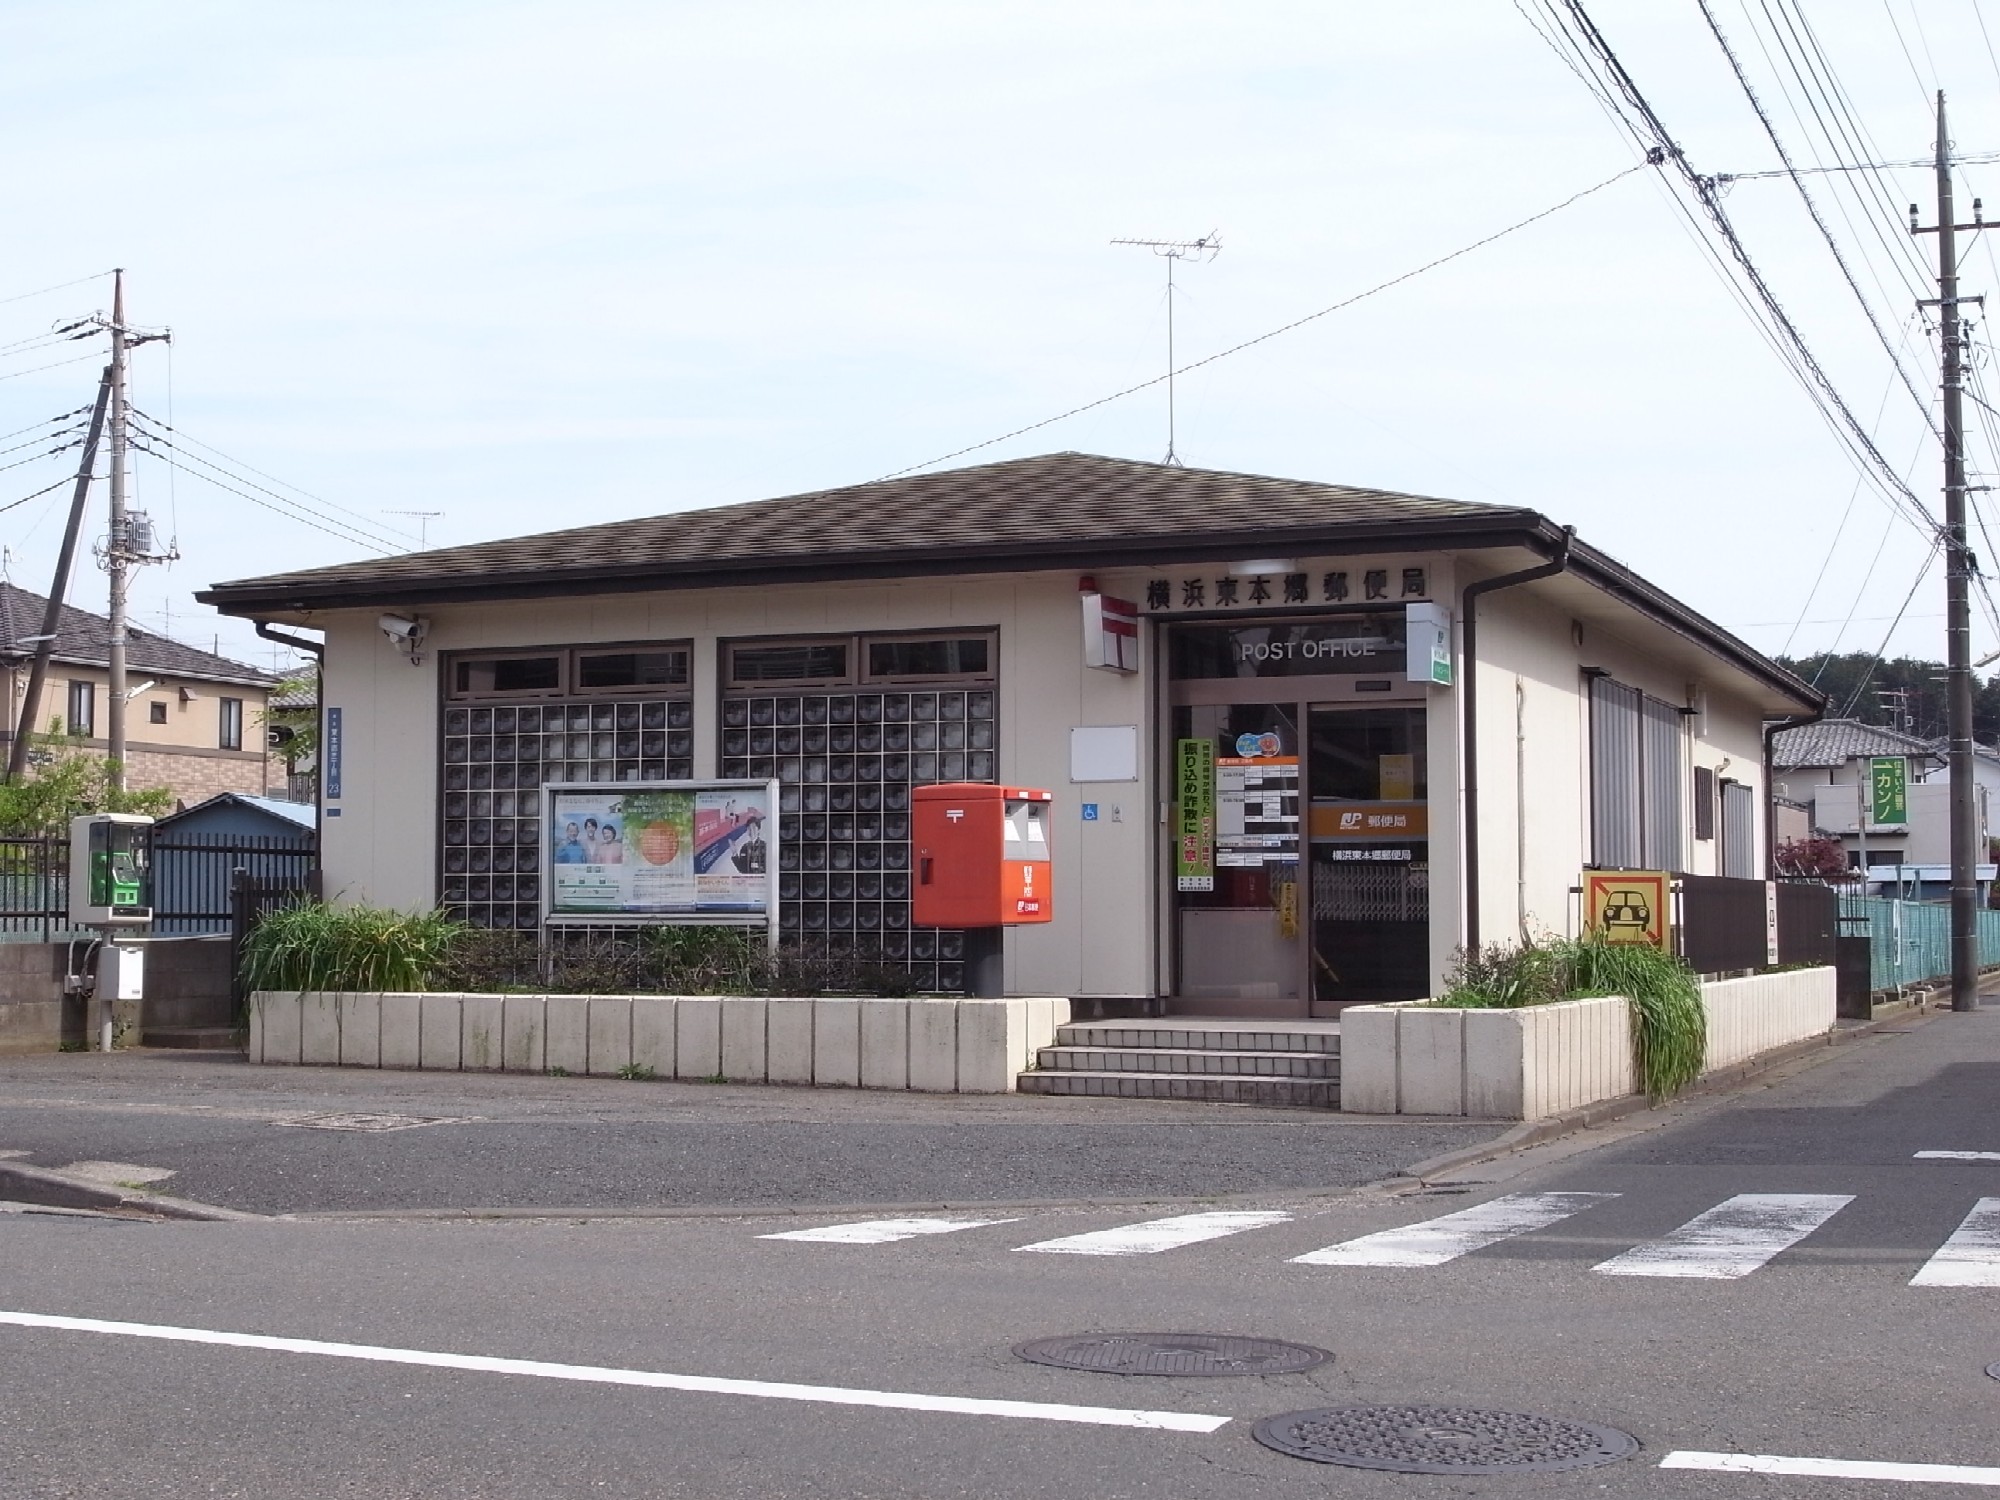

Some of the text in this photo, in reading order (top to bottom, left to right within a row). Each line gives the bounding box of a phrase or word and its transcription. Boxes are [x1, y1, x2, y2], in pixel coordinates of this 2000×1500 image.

[1147, 568, 1425, 610] 横浜東本郷郵便局
[1241, 640, 1376, 661] POST OFFICE
[1877, 773, 1891, 820] カンノ
[1368, 815, 1406, 828] 郵便局
[1332, 849, 1411, 861] 横浜東本郷郵便局
